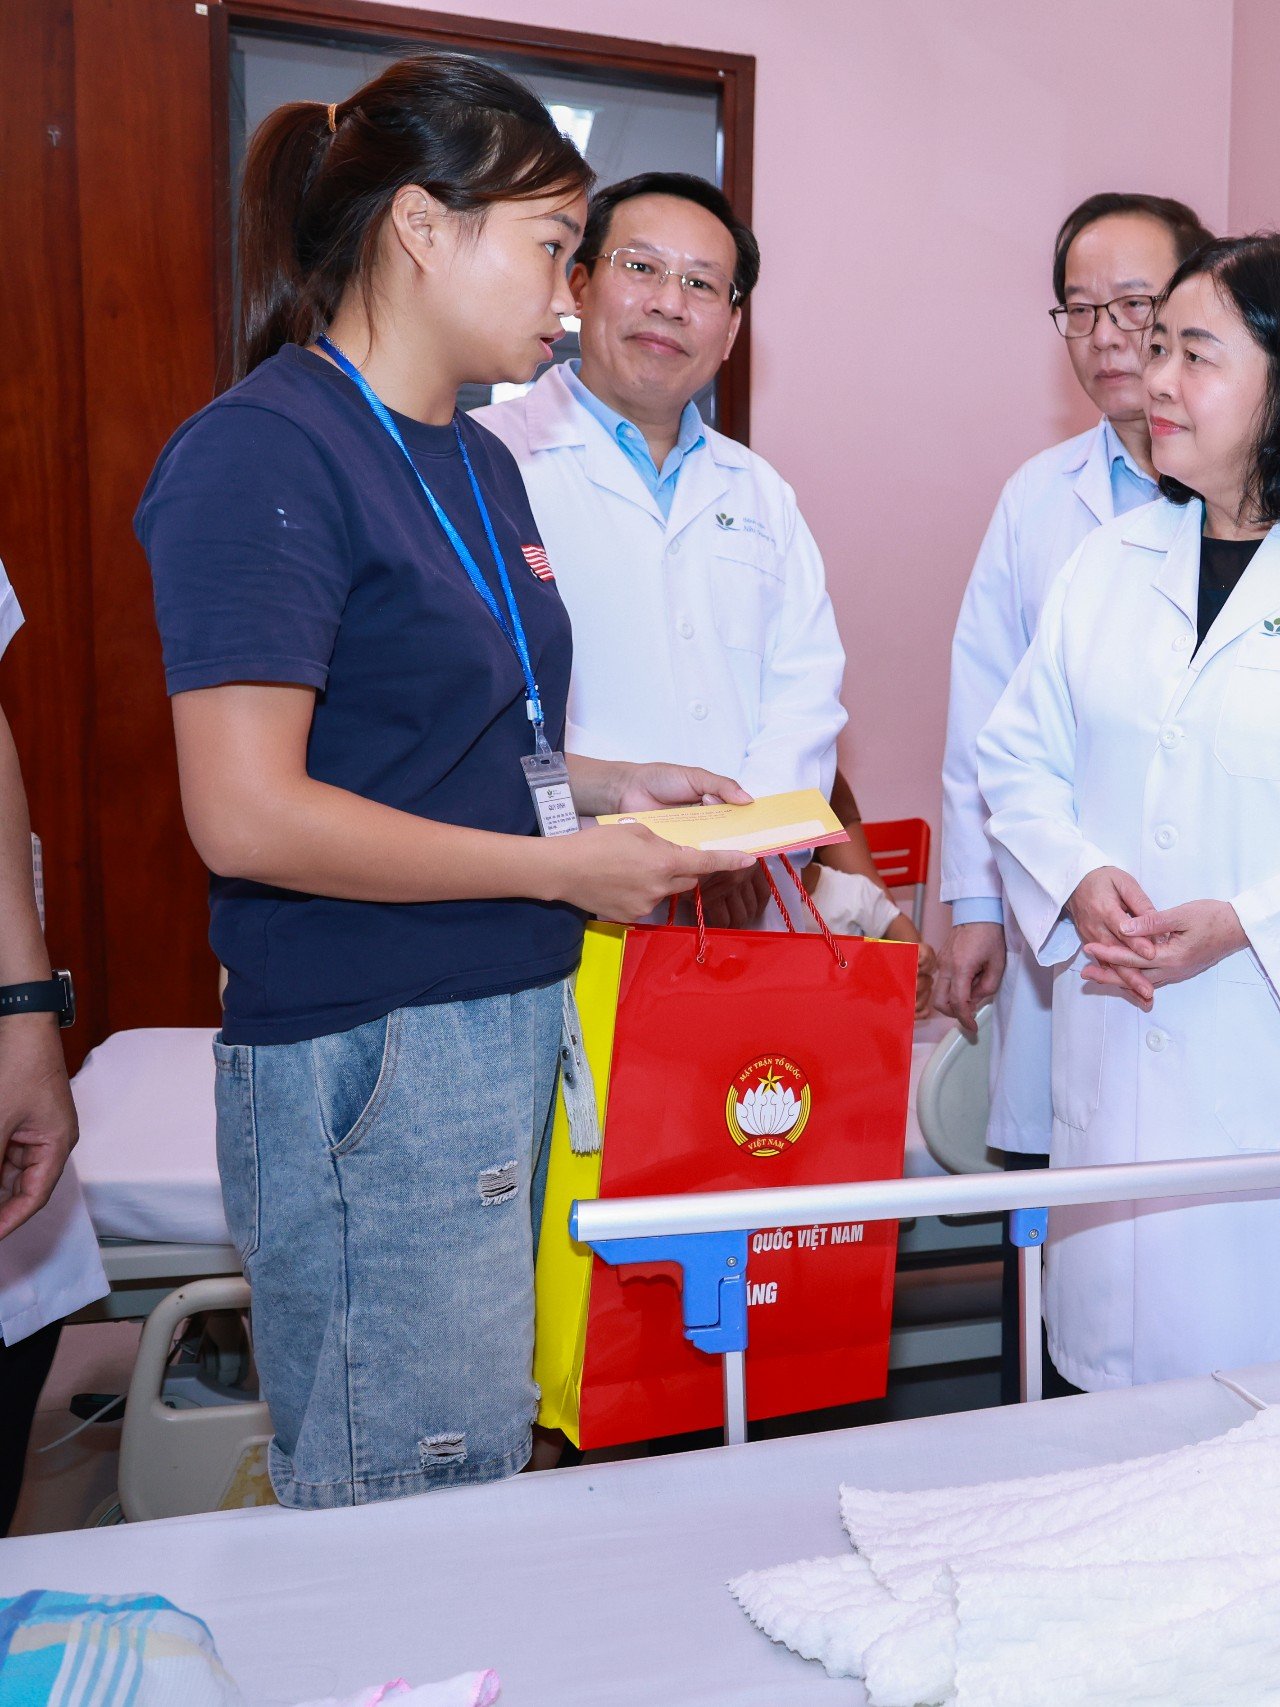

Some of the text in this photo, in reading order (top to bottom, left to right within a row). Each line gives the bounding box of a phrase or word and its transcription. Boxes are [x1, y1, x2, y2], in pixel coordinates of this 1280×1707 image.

[740, 1066, 755, 1082] MẶT
[754, 1058, 772, 1069] TRẬN
[784, 1062, 801, 1080] QUỐC
[748, 1138, 785, 1150] VIỆT NAM
[752, 1224, 864, 1254] QUỐC VIỆT NAM
